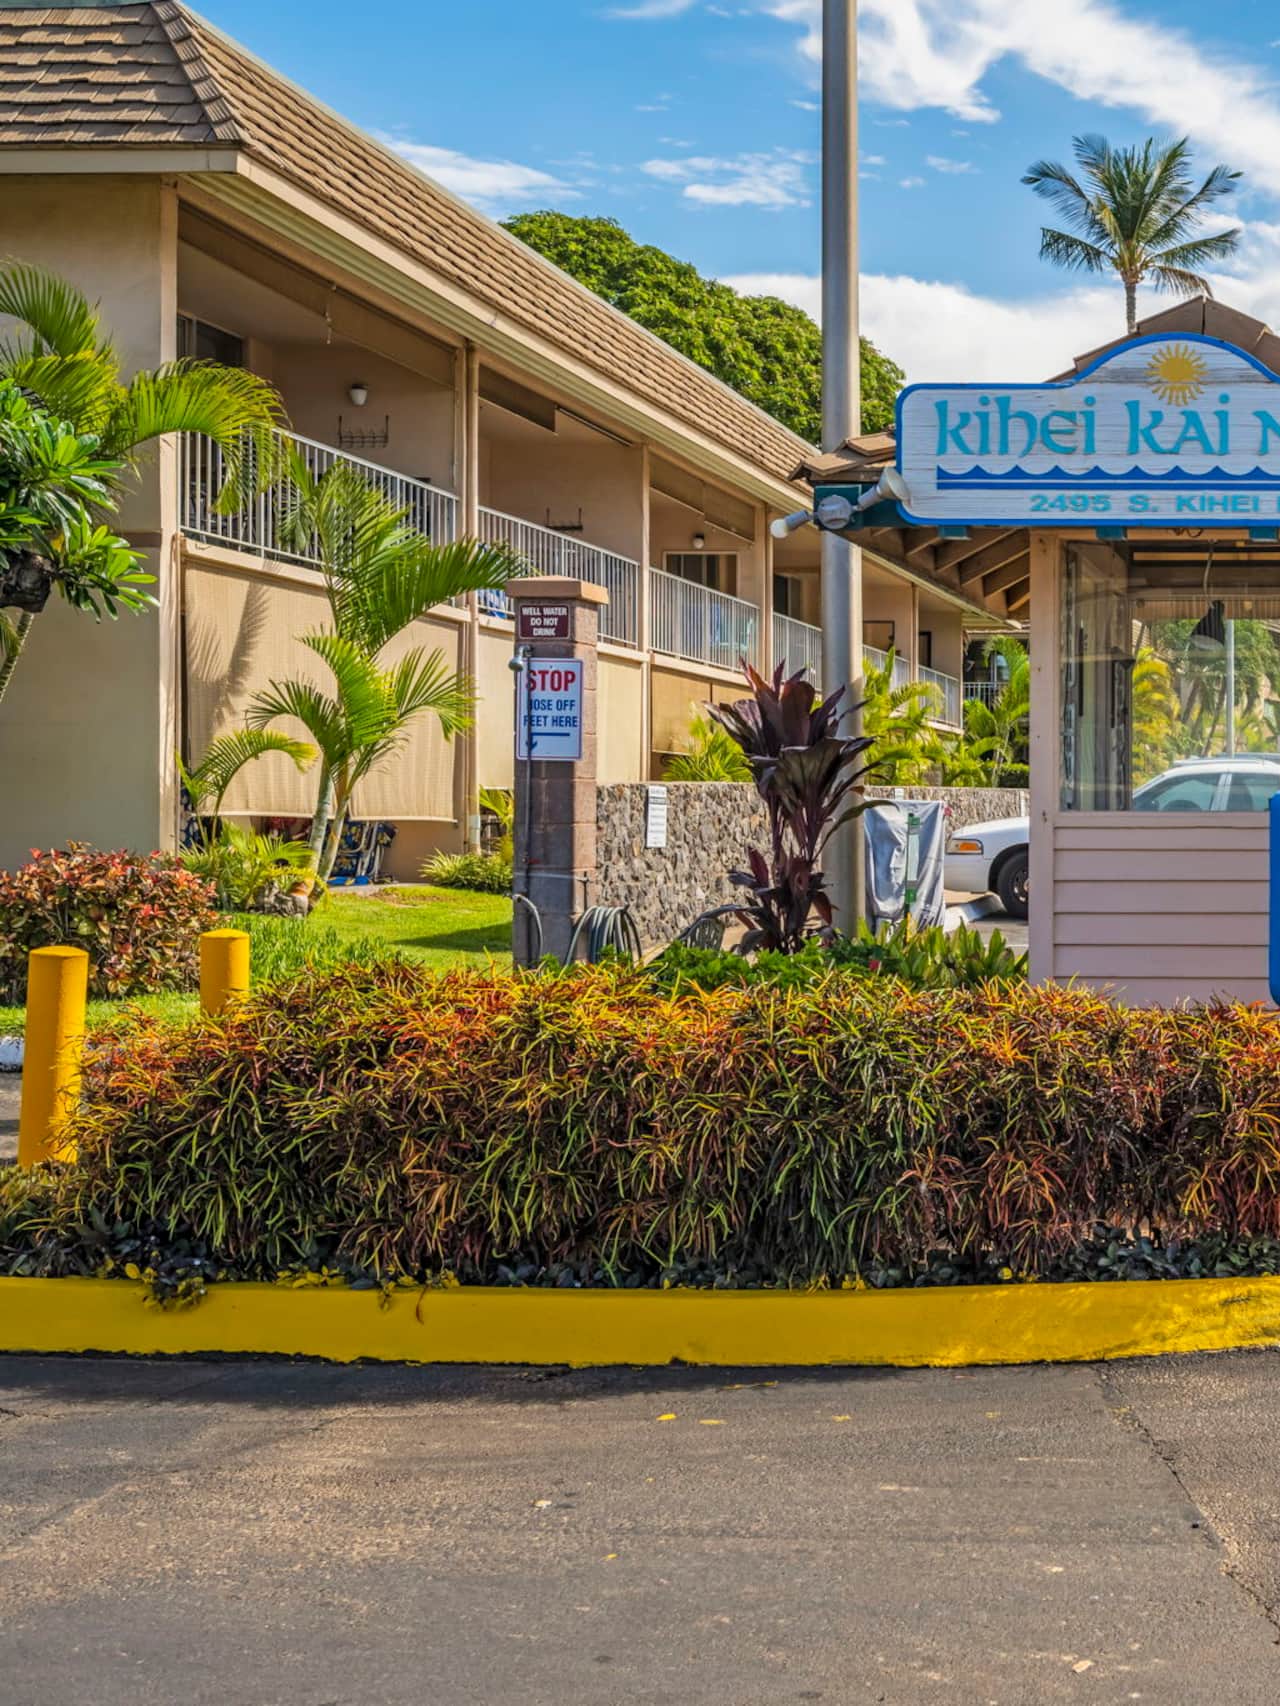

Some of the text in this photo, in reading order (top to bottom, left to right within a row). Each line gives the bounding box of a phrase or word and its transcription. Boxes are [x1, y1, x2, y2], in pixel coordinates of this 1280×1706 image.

[1030, 493, 1112, 513] 2495
[1128, 494, 1159, 513] S.
[1176, 493, 1260, 513] KIHEI
[521, 606, 568, 616] WELL WATER
[530, 617, 559, 626] DO NOT
[526, 670, 576, 691] STOP
[556, 699, 576, 711] OFF
[523, 715, 578, 728] FEET HERE
